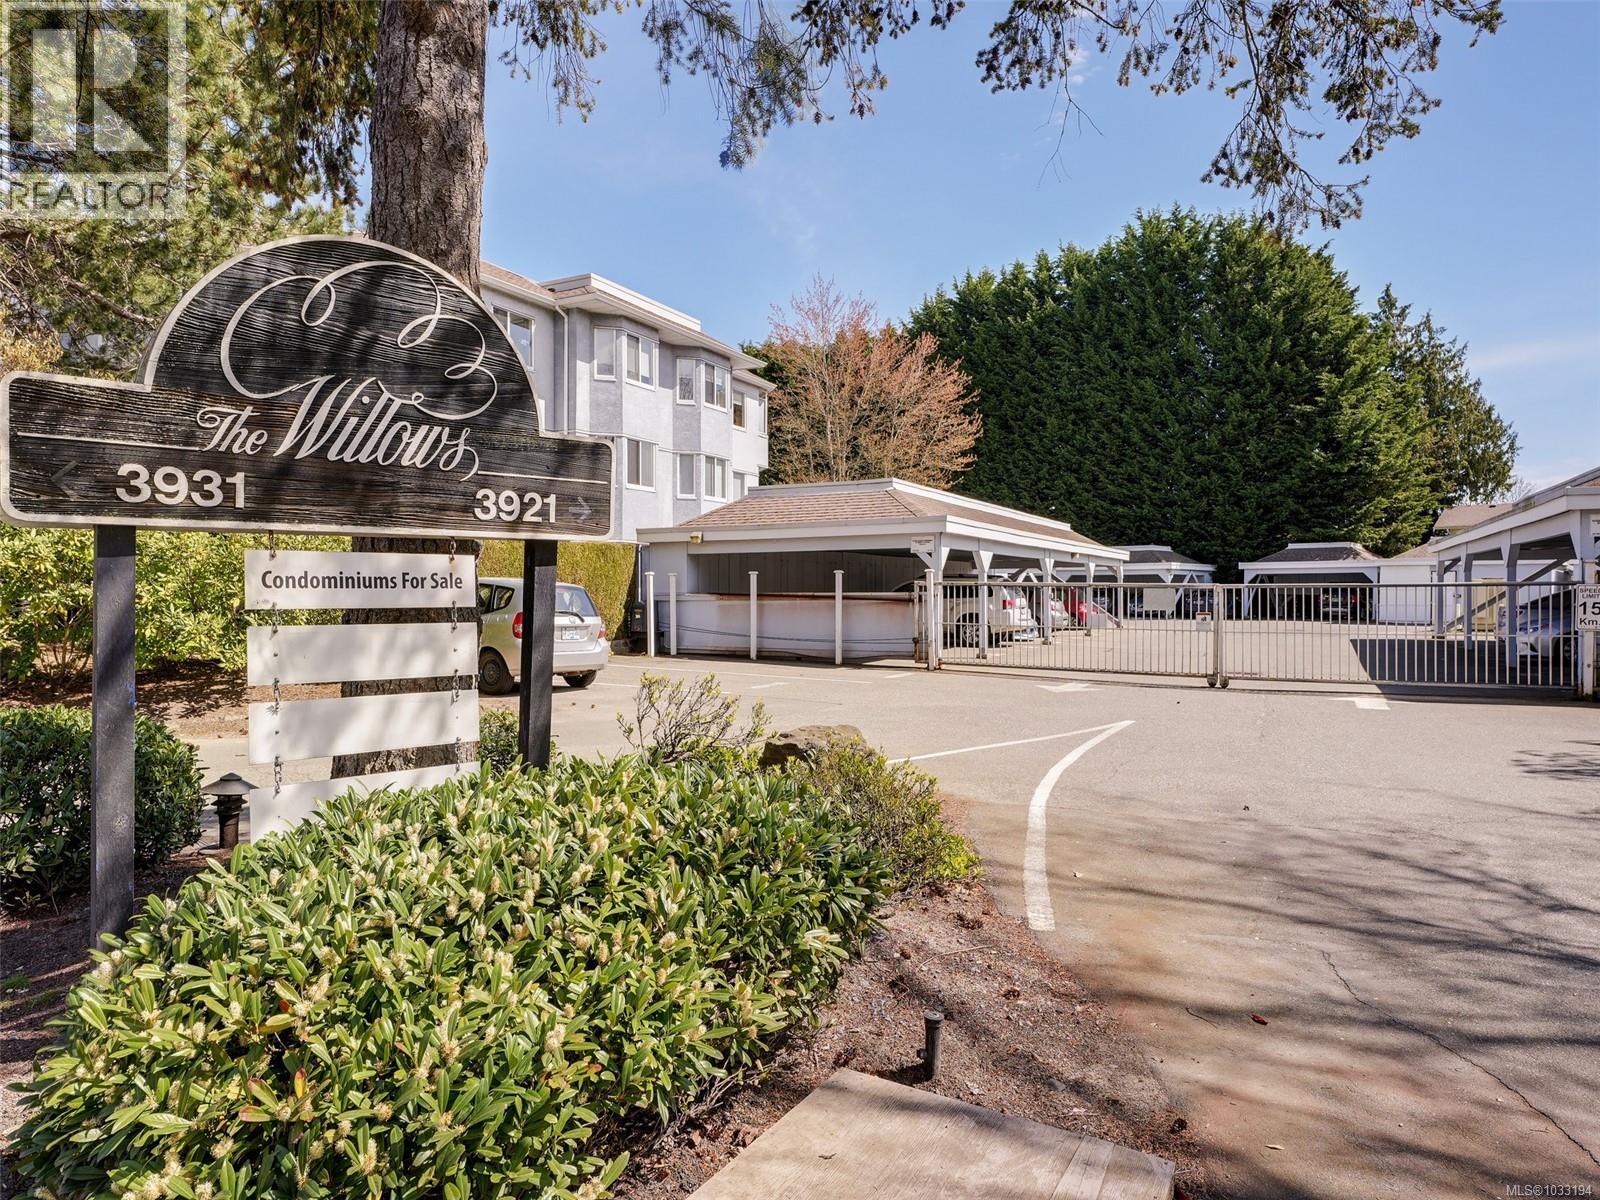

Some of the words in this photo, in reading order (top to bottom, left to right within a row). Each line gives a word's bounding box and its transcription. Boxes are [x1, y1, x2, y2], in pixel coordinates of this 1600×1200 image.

[196, 405, 269, 456] The
[272, 374, 480, 482] Willows
[115, 462, 246, 509] 3931
[473, 488, 557, 524] 3921
[261, 570, 398, 590] Condominiums
[401, 572, 427, 590] For
[430, 572, 463, 590] Sale
[1579, 601, 1600, 616] 15
